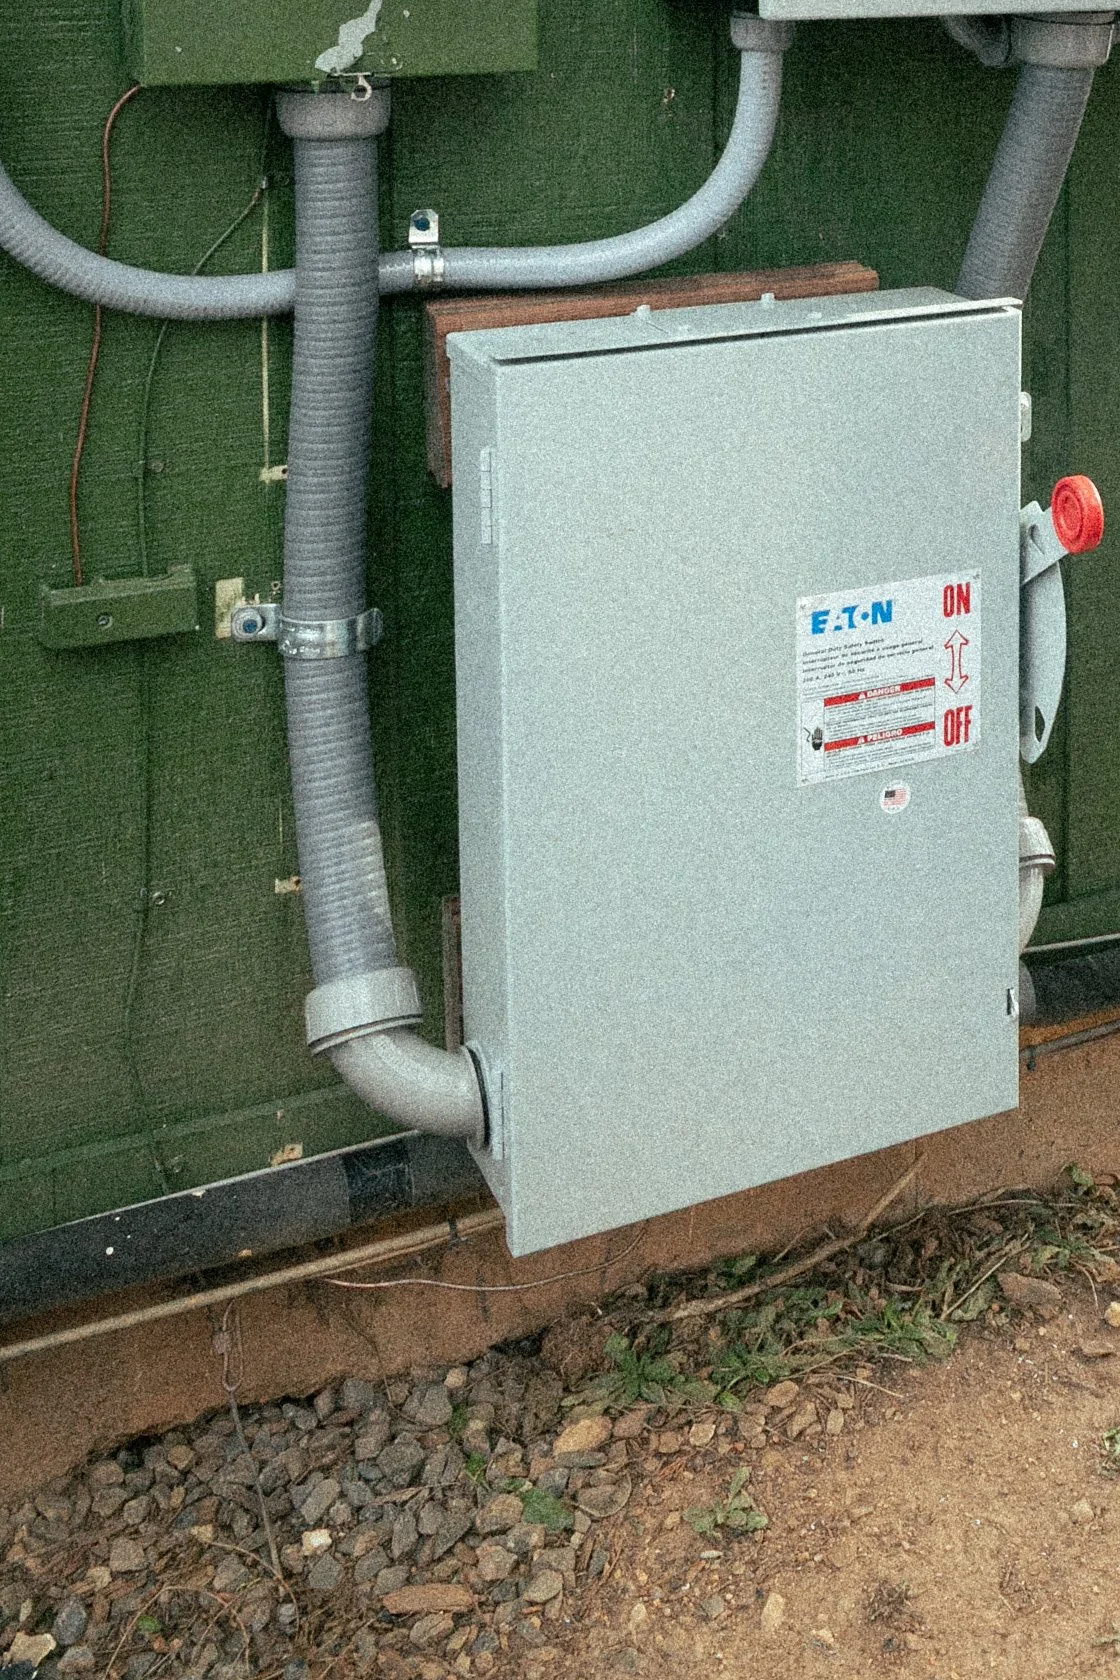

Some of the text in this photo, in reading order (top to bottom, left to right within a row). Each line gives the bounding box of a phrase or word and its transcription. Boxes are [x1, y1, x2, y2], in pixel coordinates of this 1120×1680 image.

[943, 581, 971, 619] ON
[867, 685, 901, 698] DANGER
[867, 729, 903, 742] PELIGRO
[943, 705, 973, 747] OFF
